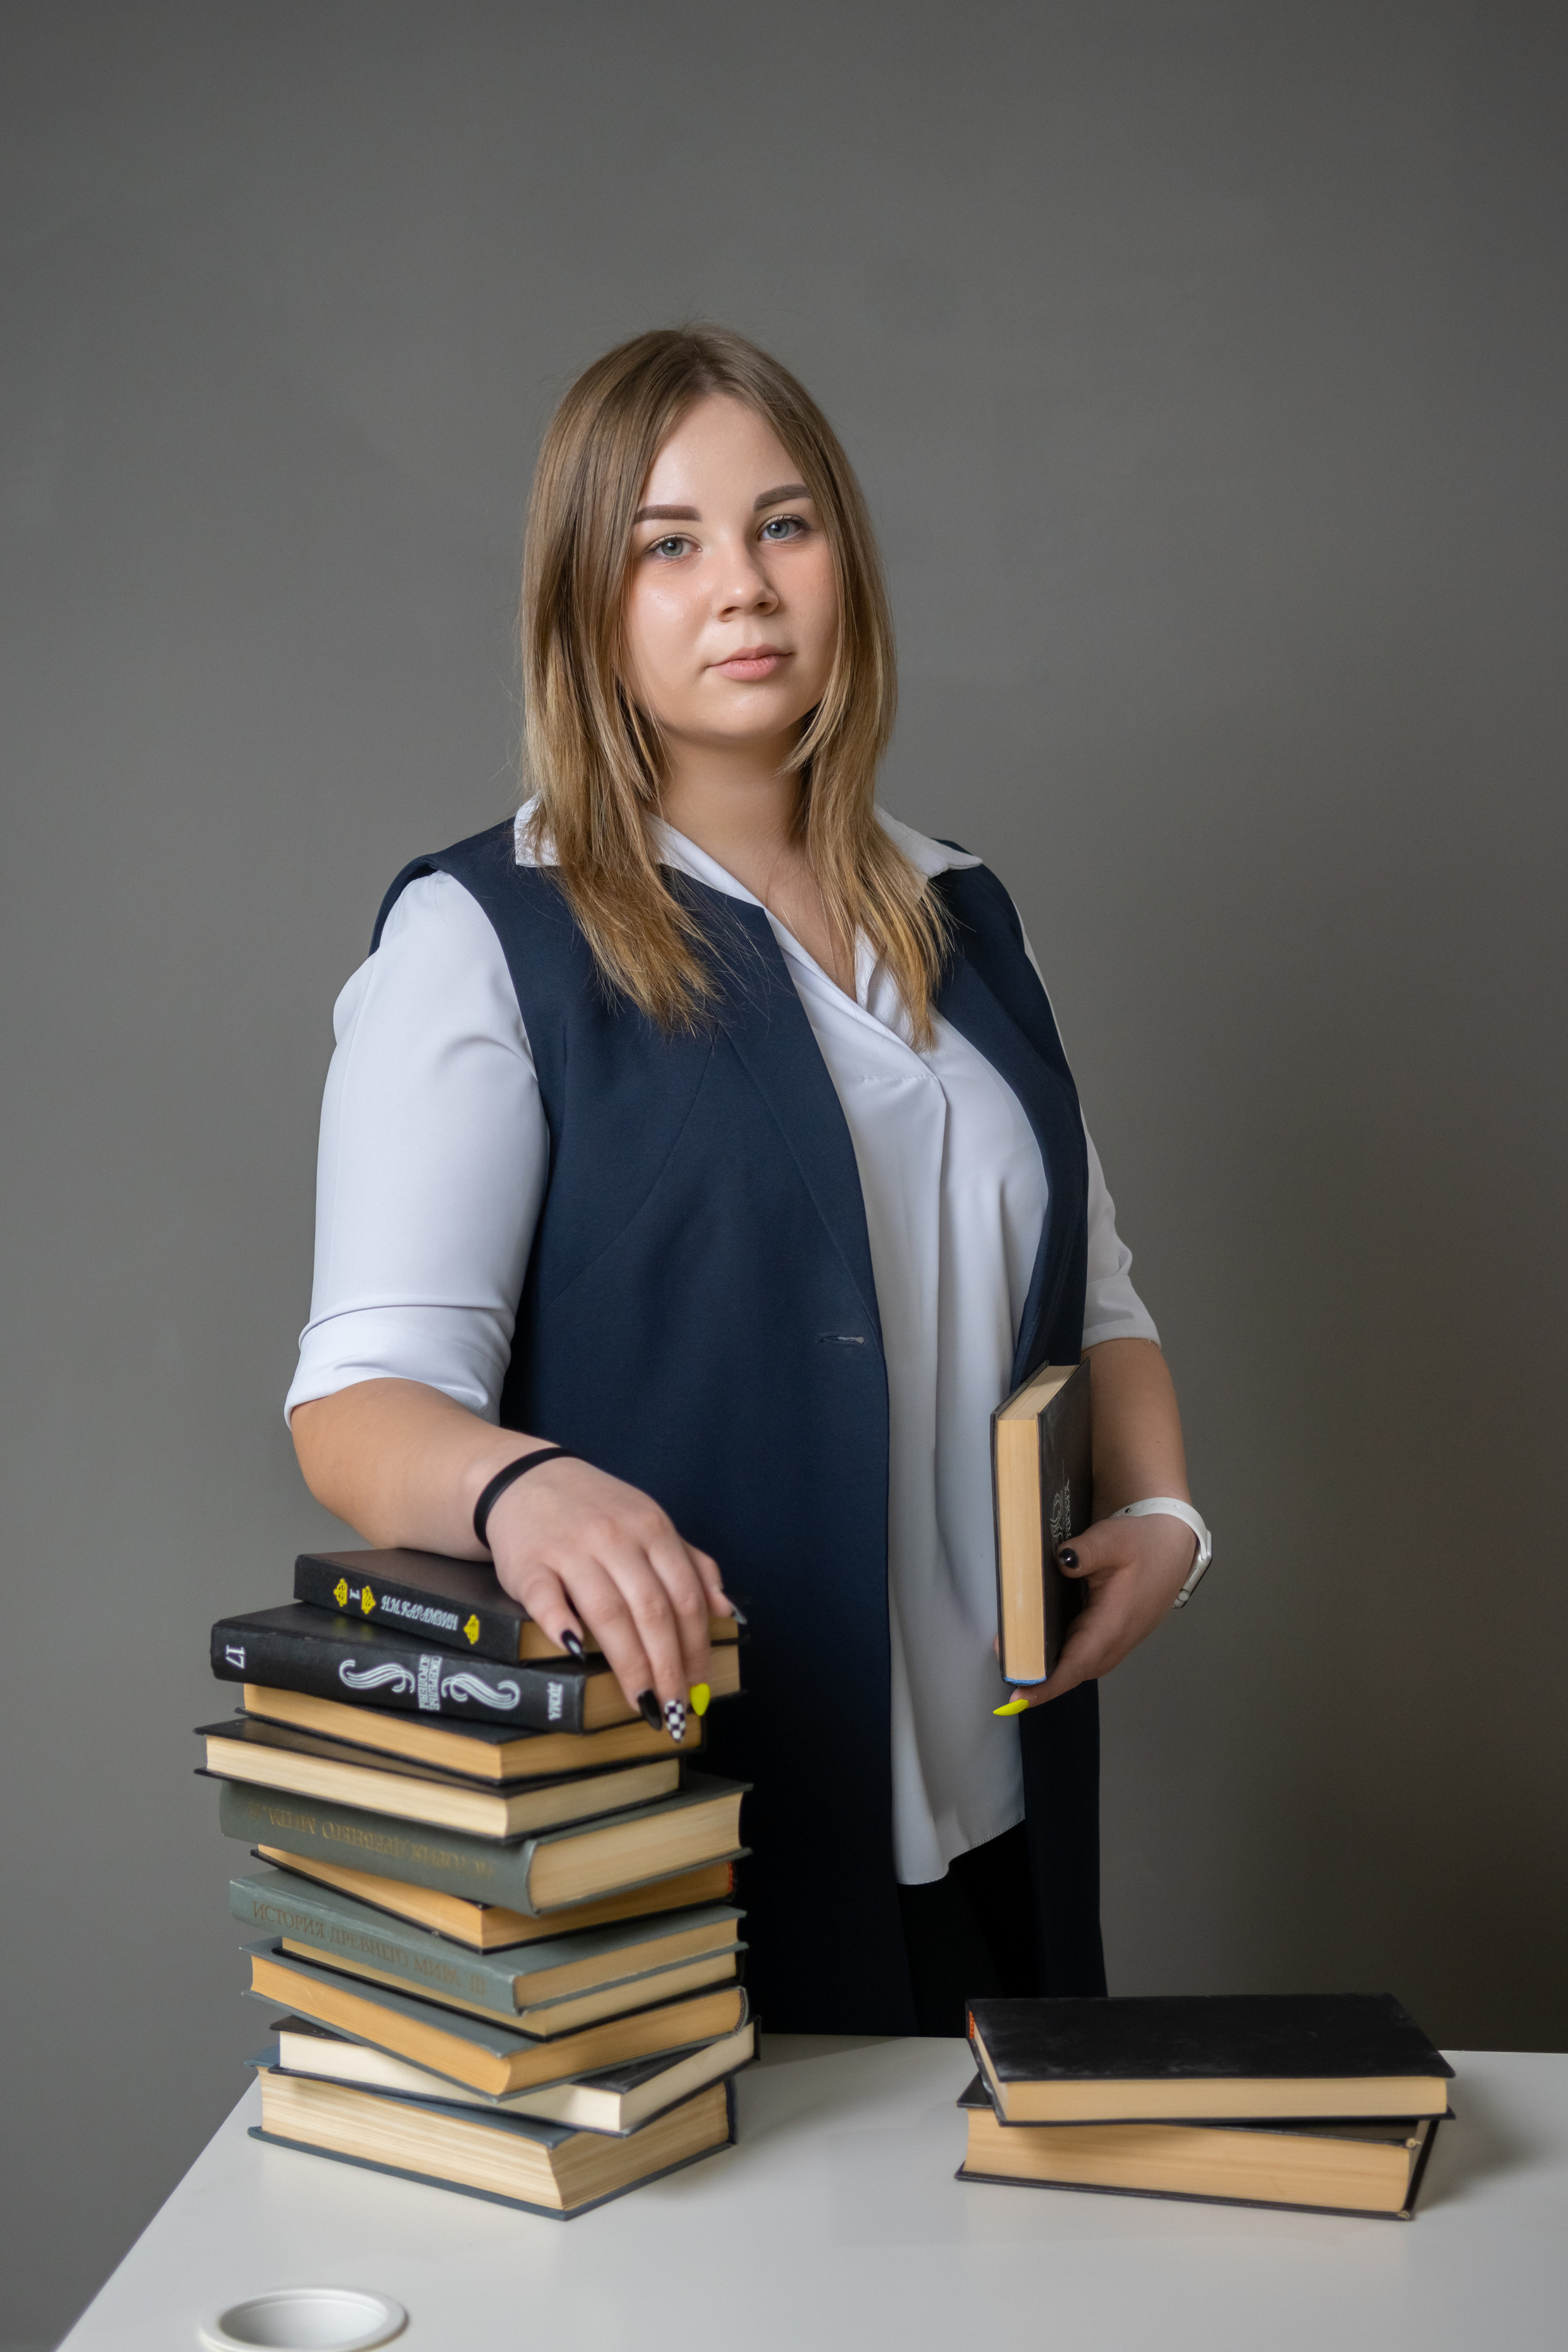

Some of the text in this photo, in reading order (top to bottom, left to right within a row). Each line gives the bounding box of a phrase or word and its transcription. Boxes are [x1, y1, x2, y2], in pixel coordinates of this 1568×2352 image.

[225, 1645, 245, 1669] 17
[418, 1654, 431, 1709] КОРОЛЕВЫ
[428, 1656, 442, 1711] ОЖЕРЕЛЬЕ
[547, 1682, 563, 1720] ДЮМА
[253, 1902, 325, 1939] ИСТОРИЯ
[330, 1927, 409, 1967] ДРЕВНЕГО
